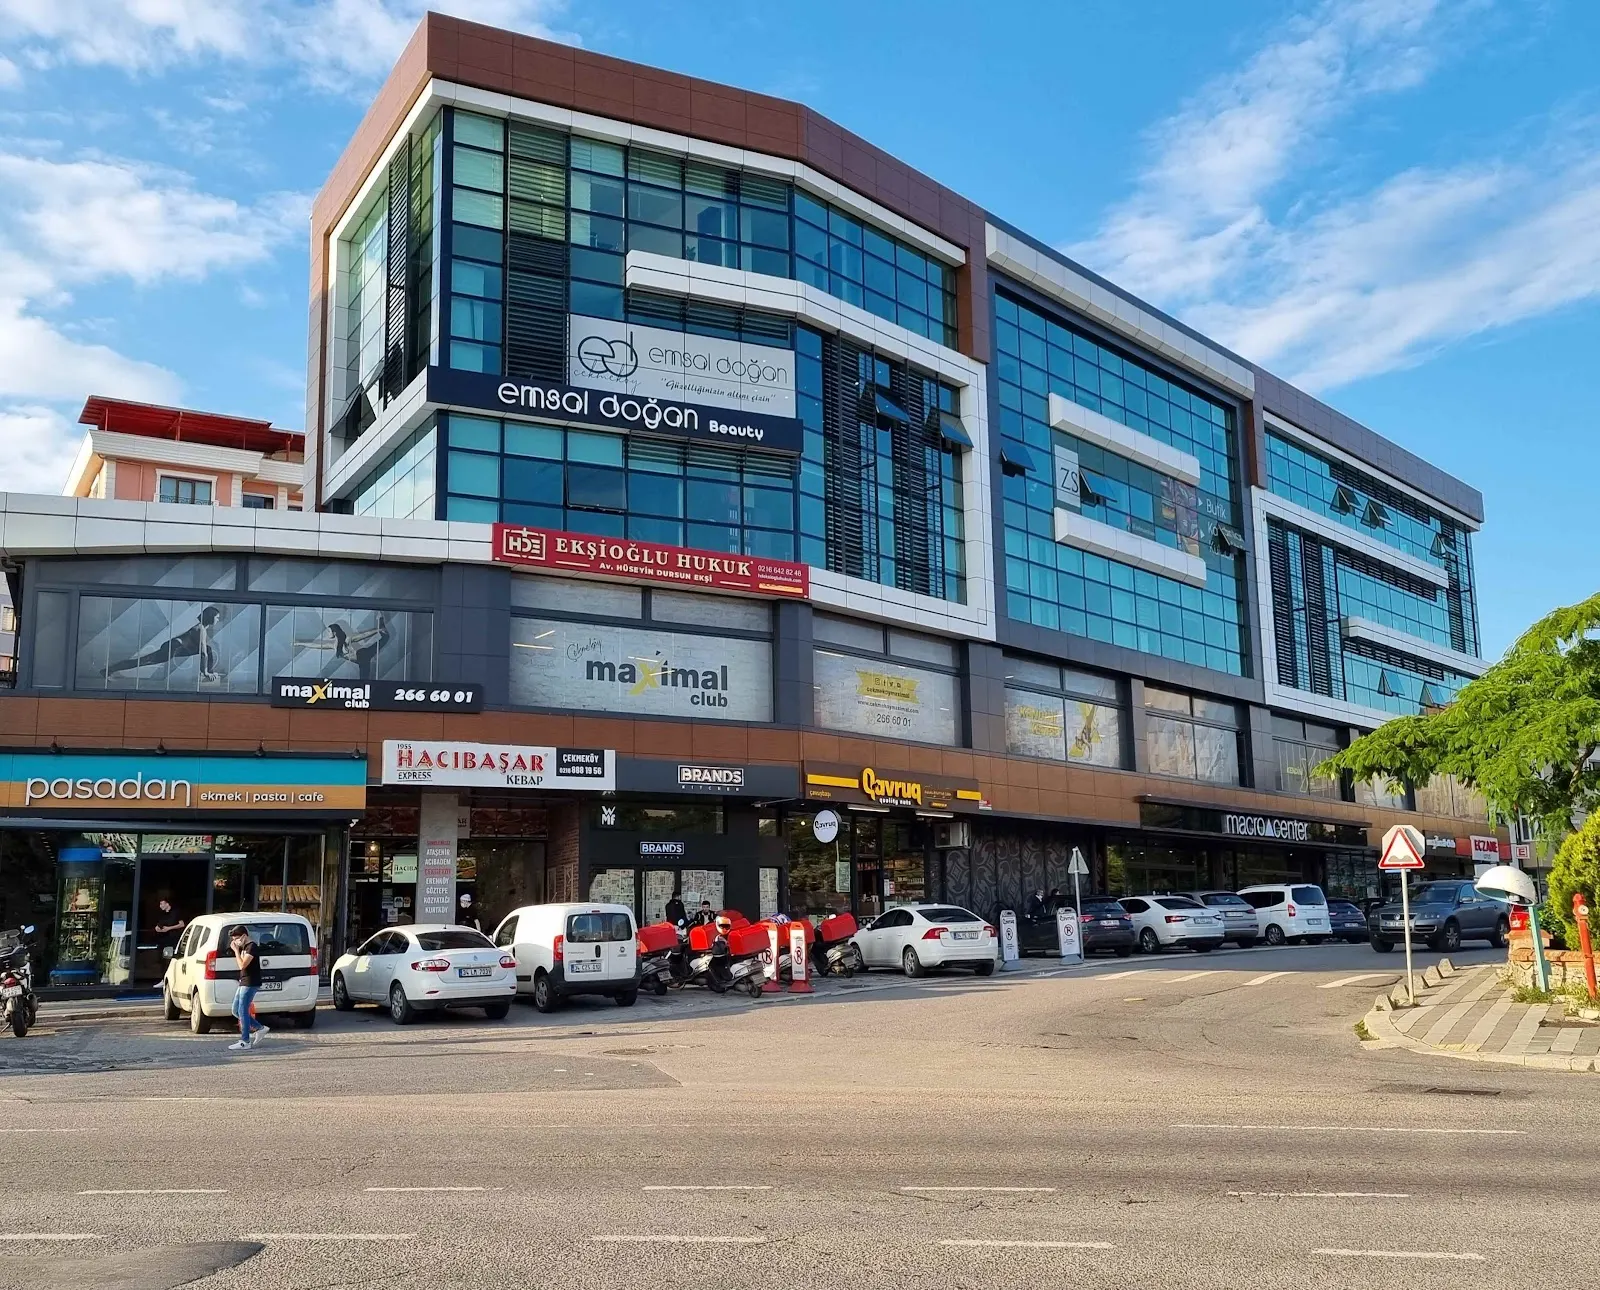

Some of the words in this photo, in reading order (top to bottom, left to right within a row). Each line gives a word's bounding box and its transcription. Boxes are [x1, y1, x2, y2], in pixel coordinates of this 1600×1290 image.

[649, 347, 711, 371] emsal
[716, 357, 788, 384] doğan
[498, 382, 589, 415] emsal
[599, 394, 698, 430] doğan
[709, 419, 764, 441] Beauty
[1060, 467, 1079, 493] ZS
[555, 537, 669, 565] EKŞİOĞLU
[676, 553, 751, 576] HUKUK
[599, 562, 614, 570] Av.
[616, 563, 654, 575] HÜSEYİN
[656, 569, 691, 579] DURSUN
[693, 573, 713, 583] EKŞİ
[757, 565, 773, 573] 0216
[773, 567, 785, 575] 642
[586, 651, 728, 695] maximal
[280, 678, 370, 704] maximal
[394, 688, 425, 701] 266
[429, 689, 450, 702] 60
[454, 691, 473, 703] 01
[344, 699, 370, 709] club
[690, 692, 728, 707] club
[877, 713, 891, 724] 266
[892, 716, 901, 726] 60
[902, 717, 911, 727] 01
[397, 749, 544, 774] HACIBAŞAR
[562, 753, 599, 763] ÇEKMEKÖY
[571, 766, 585, 774] 888
[585, 766, 593, 775] 19
[681, 767, 742, 783] BRANDS
[398, 771, 432, 780] EXPRESS
[506, 775, 543, 786] KEBAP
[25, 771, 191, 807] pasadan
[200, 791, 242, 801] ekmek
[253, 792, 287, 803] pasta
[298, 791, 324, 802] cafe
[862, 767, 922, 806] Qavruq
[642, 843, 682, 853] BRANDS
[1474, 839, 1498, 853] ECZANE
[424, 858, 451, 866] ACIBADEM
[425, 886, 449, 895] GÖZTEPE
